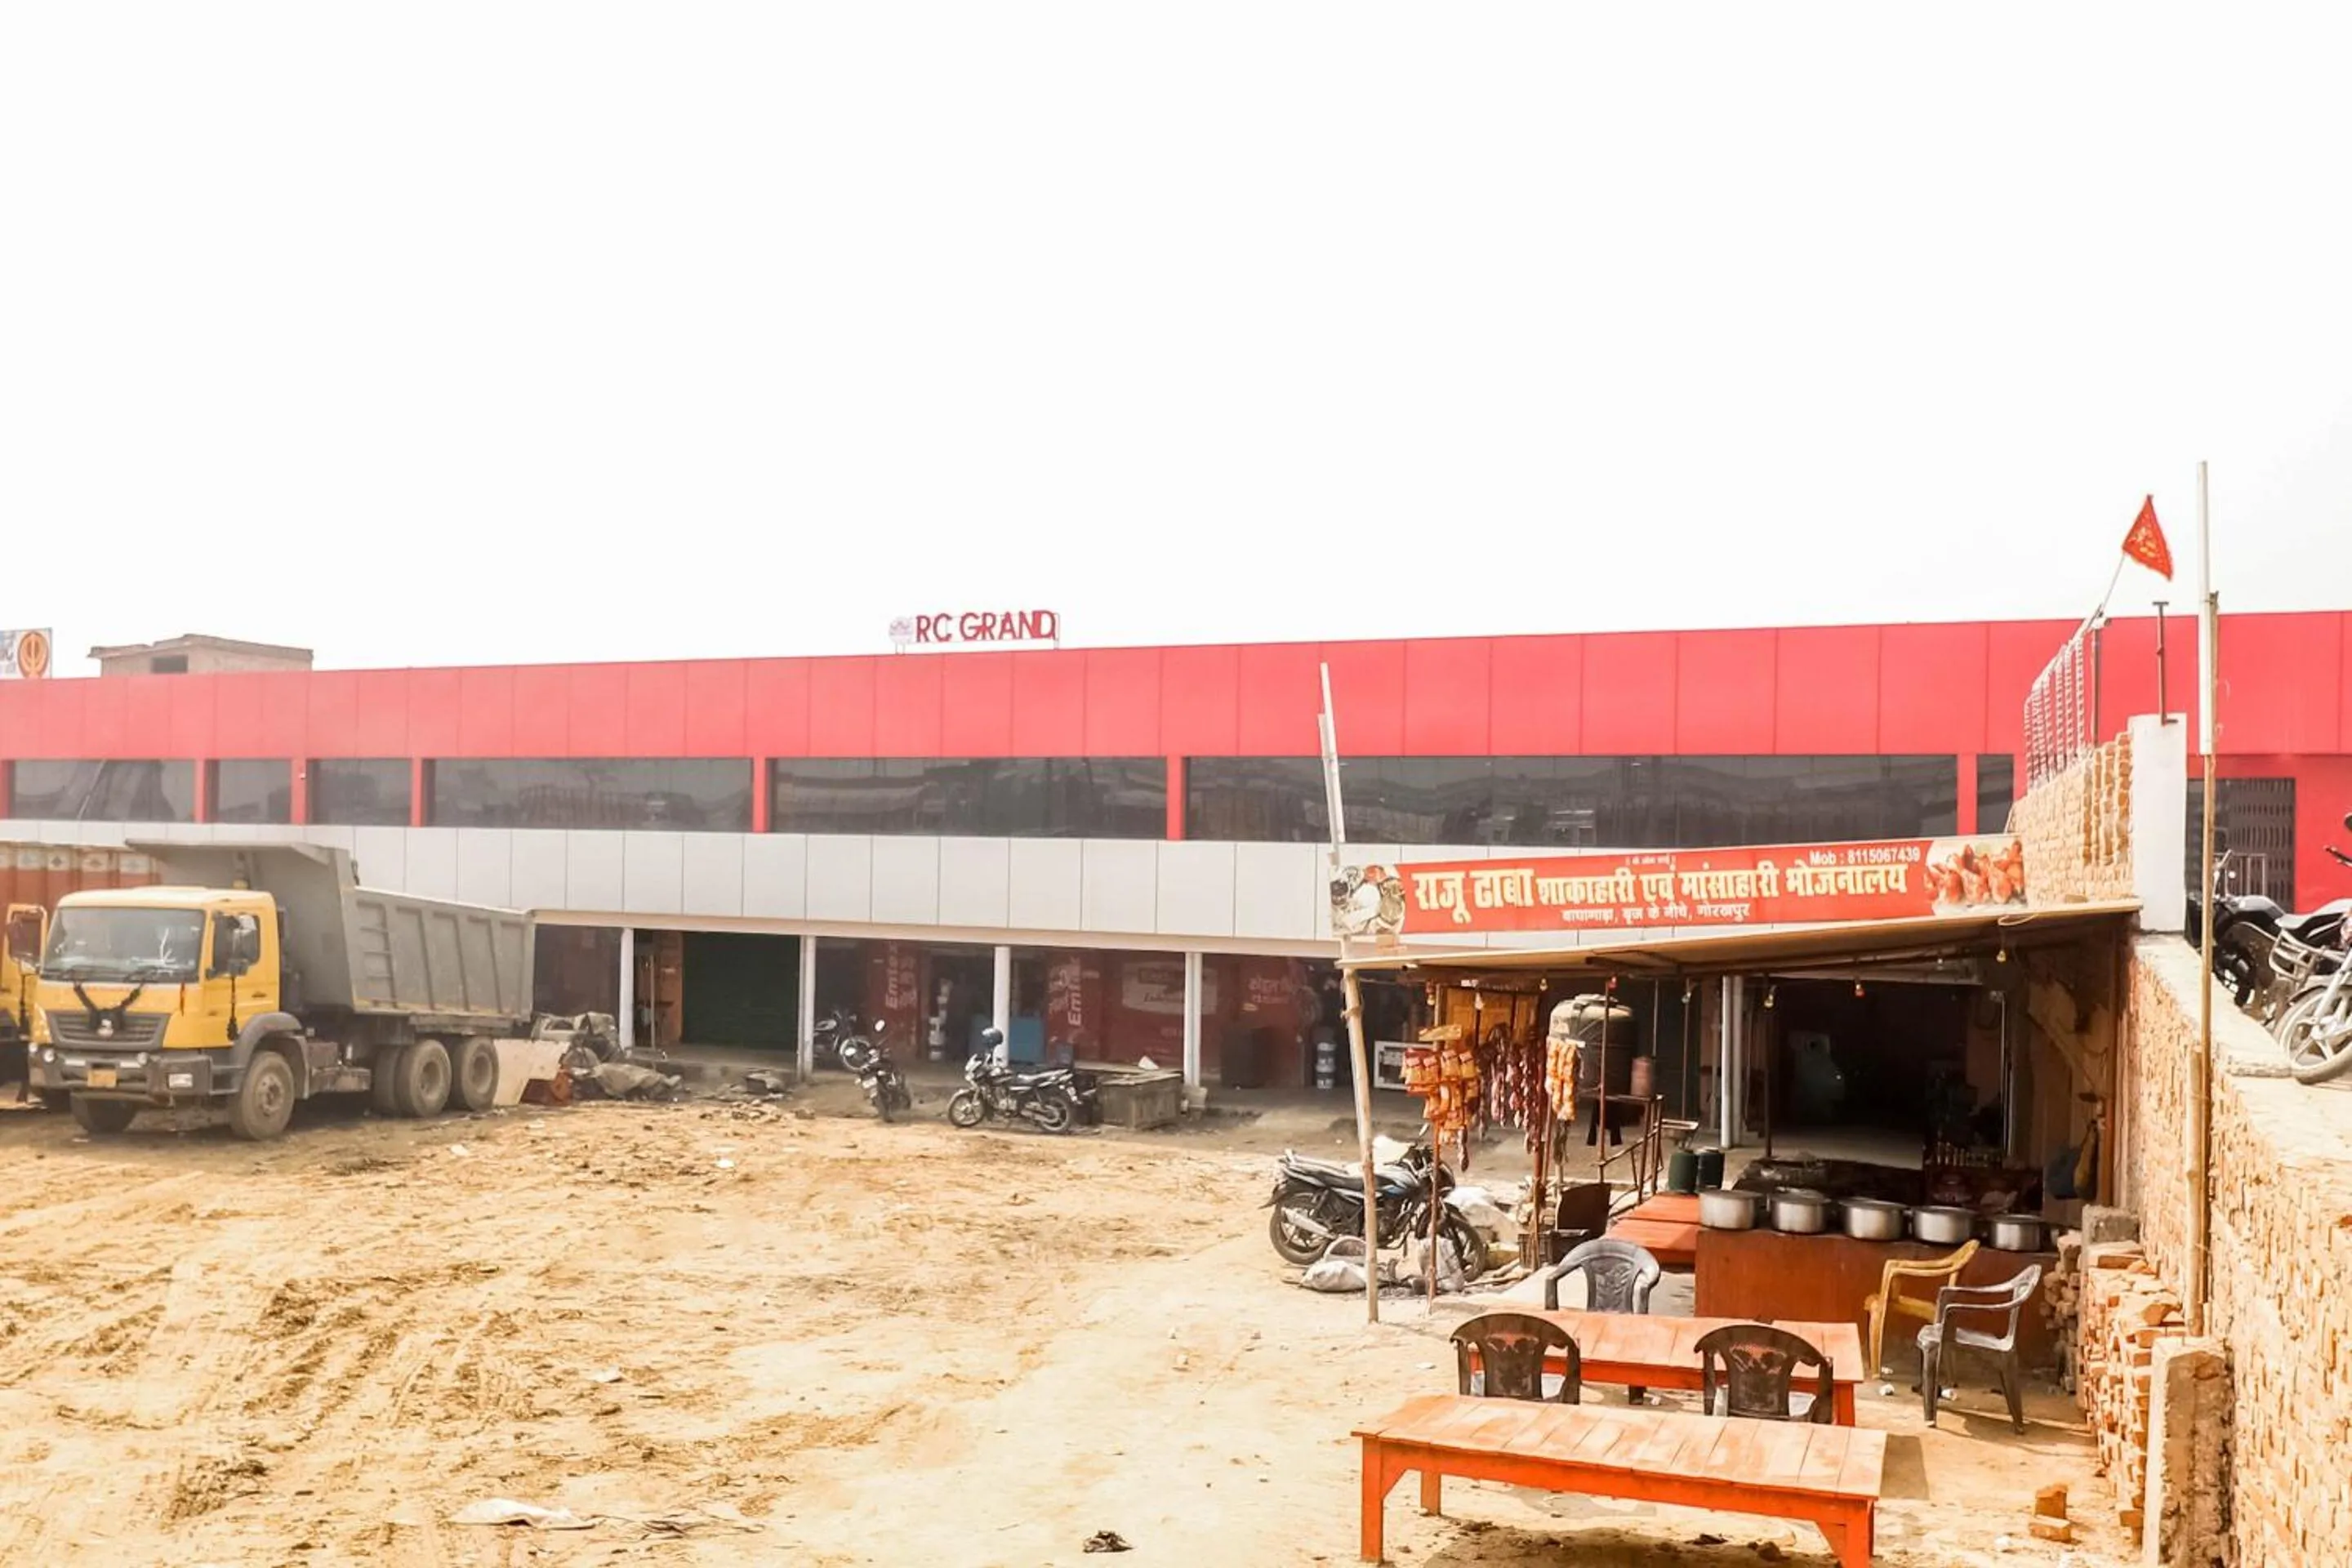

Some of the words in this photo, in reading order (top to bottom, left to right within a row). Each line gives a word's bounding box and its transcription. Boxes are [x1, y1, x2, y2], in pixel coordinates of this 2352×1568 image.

[915, 614, 952, 643] RC
[960, 610, 1056, 640] GRAND
[1810, 850, 1837, 866] Mob
[1411, 871, 1472, 924] राजू
[1469, 868, 1535, 908] ढाबा
[1535, 866, 1636, 905] शाकाहारी
[1639, 863, 1677, 903] एवं
[1678, 859, 1780, 901] मांसाहारी
[1785, 858, 1909, 897] भोजनालय
[1647, 902, 1660, 920] के
[1696, 900, 1750, 923] गोरखपुर
